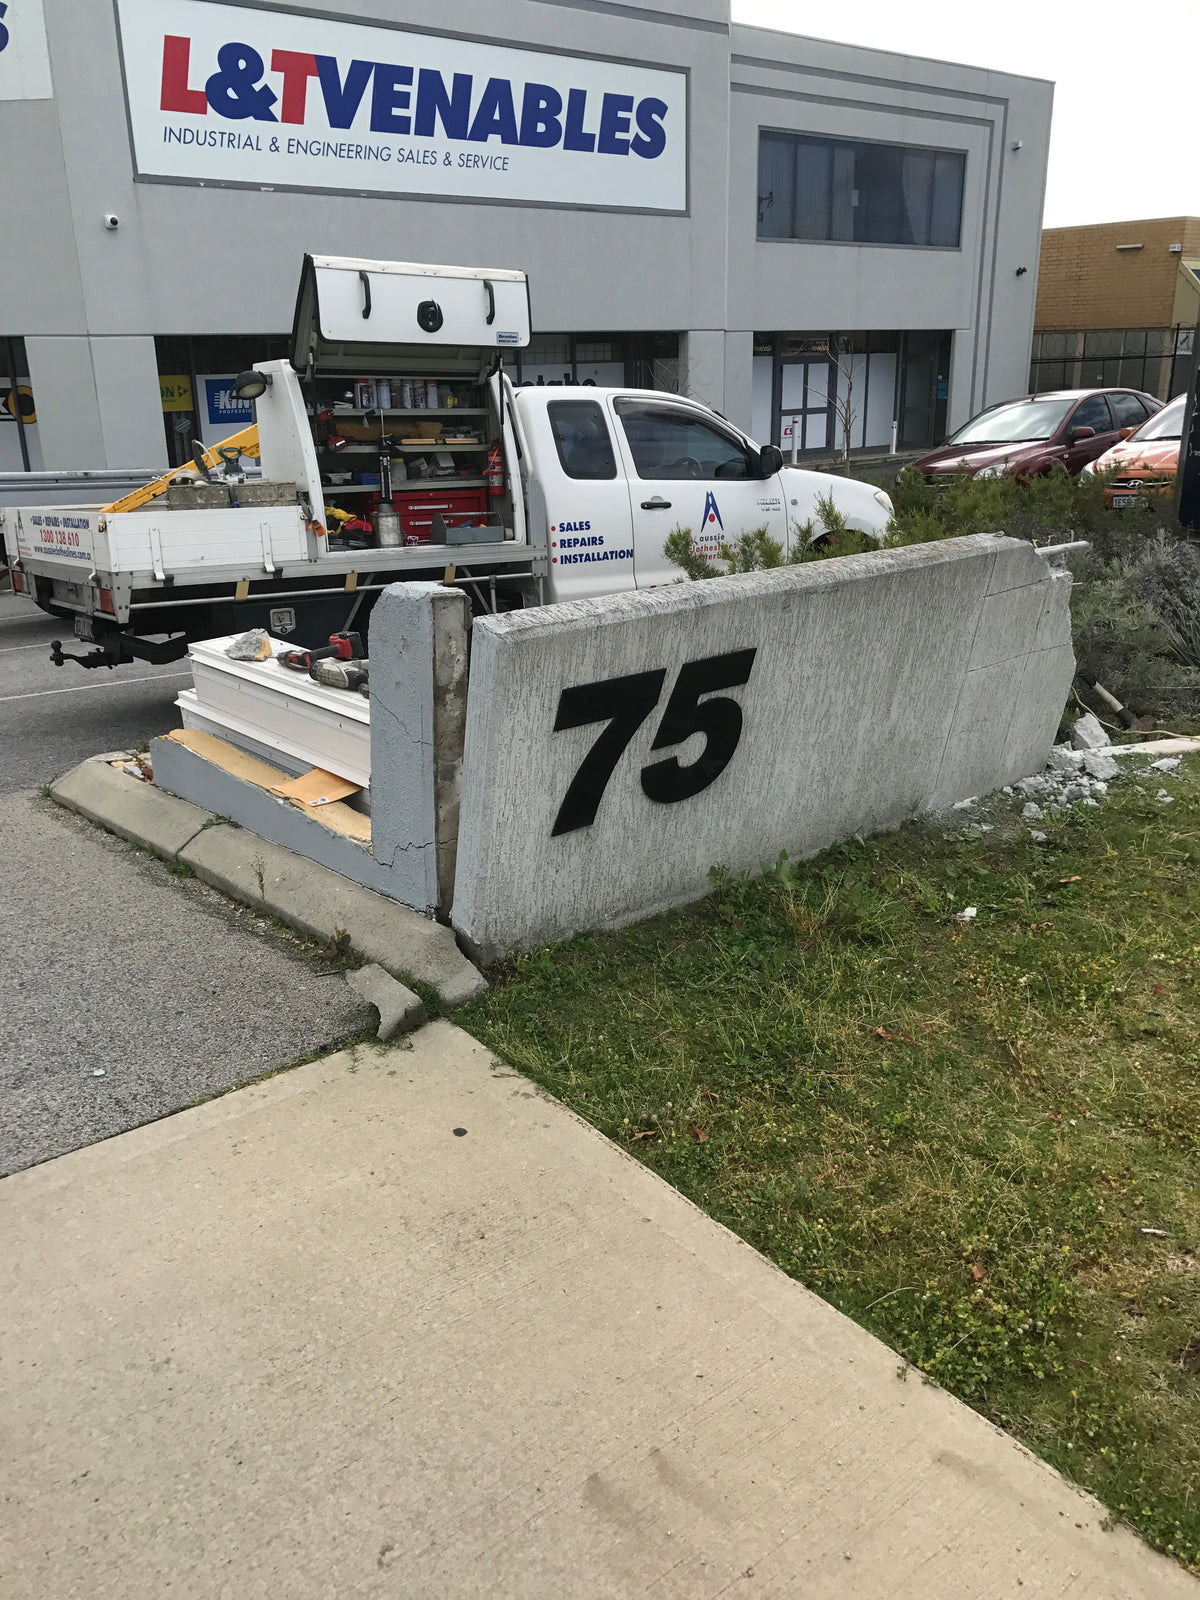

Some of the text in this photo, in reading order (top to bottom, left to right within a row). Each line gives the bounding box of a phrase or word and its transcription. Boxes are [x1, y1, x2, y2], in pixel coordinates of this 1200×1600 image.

[163, 126, 509, 171] INDUSTRIAL & ENGINEERING SALES & SERVICE
[559, 521, 591, 532] SALES
[40, 529, 80, 547] 1300 138 610
[559, 536, 604, 549] REPAIRS
[699, 533, 725, 542] aussie
[560, 549, 634, 565] INSTALLATION
[551, 648, 757, 837] 75
